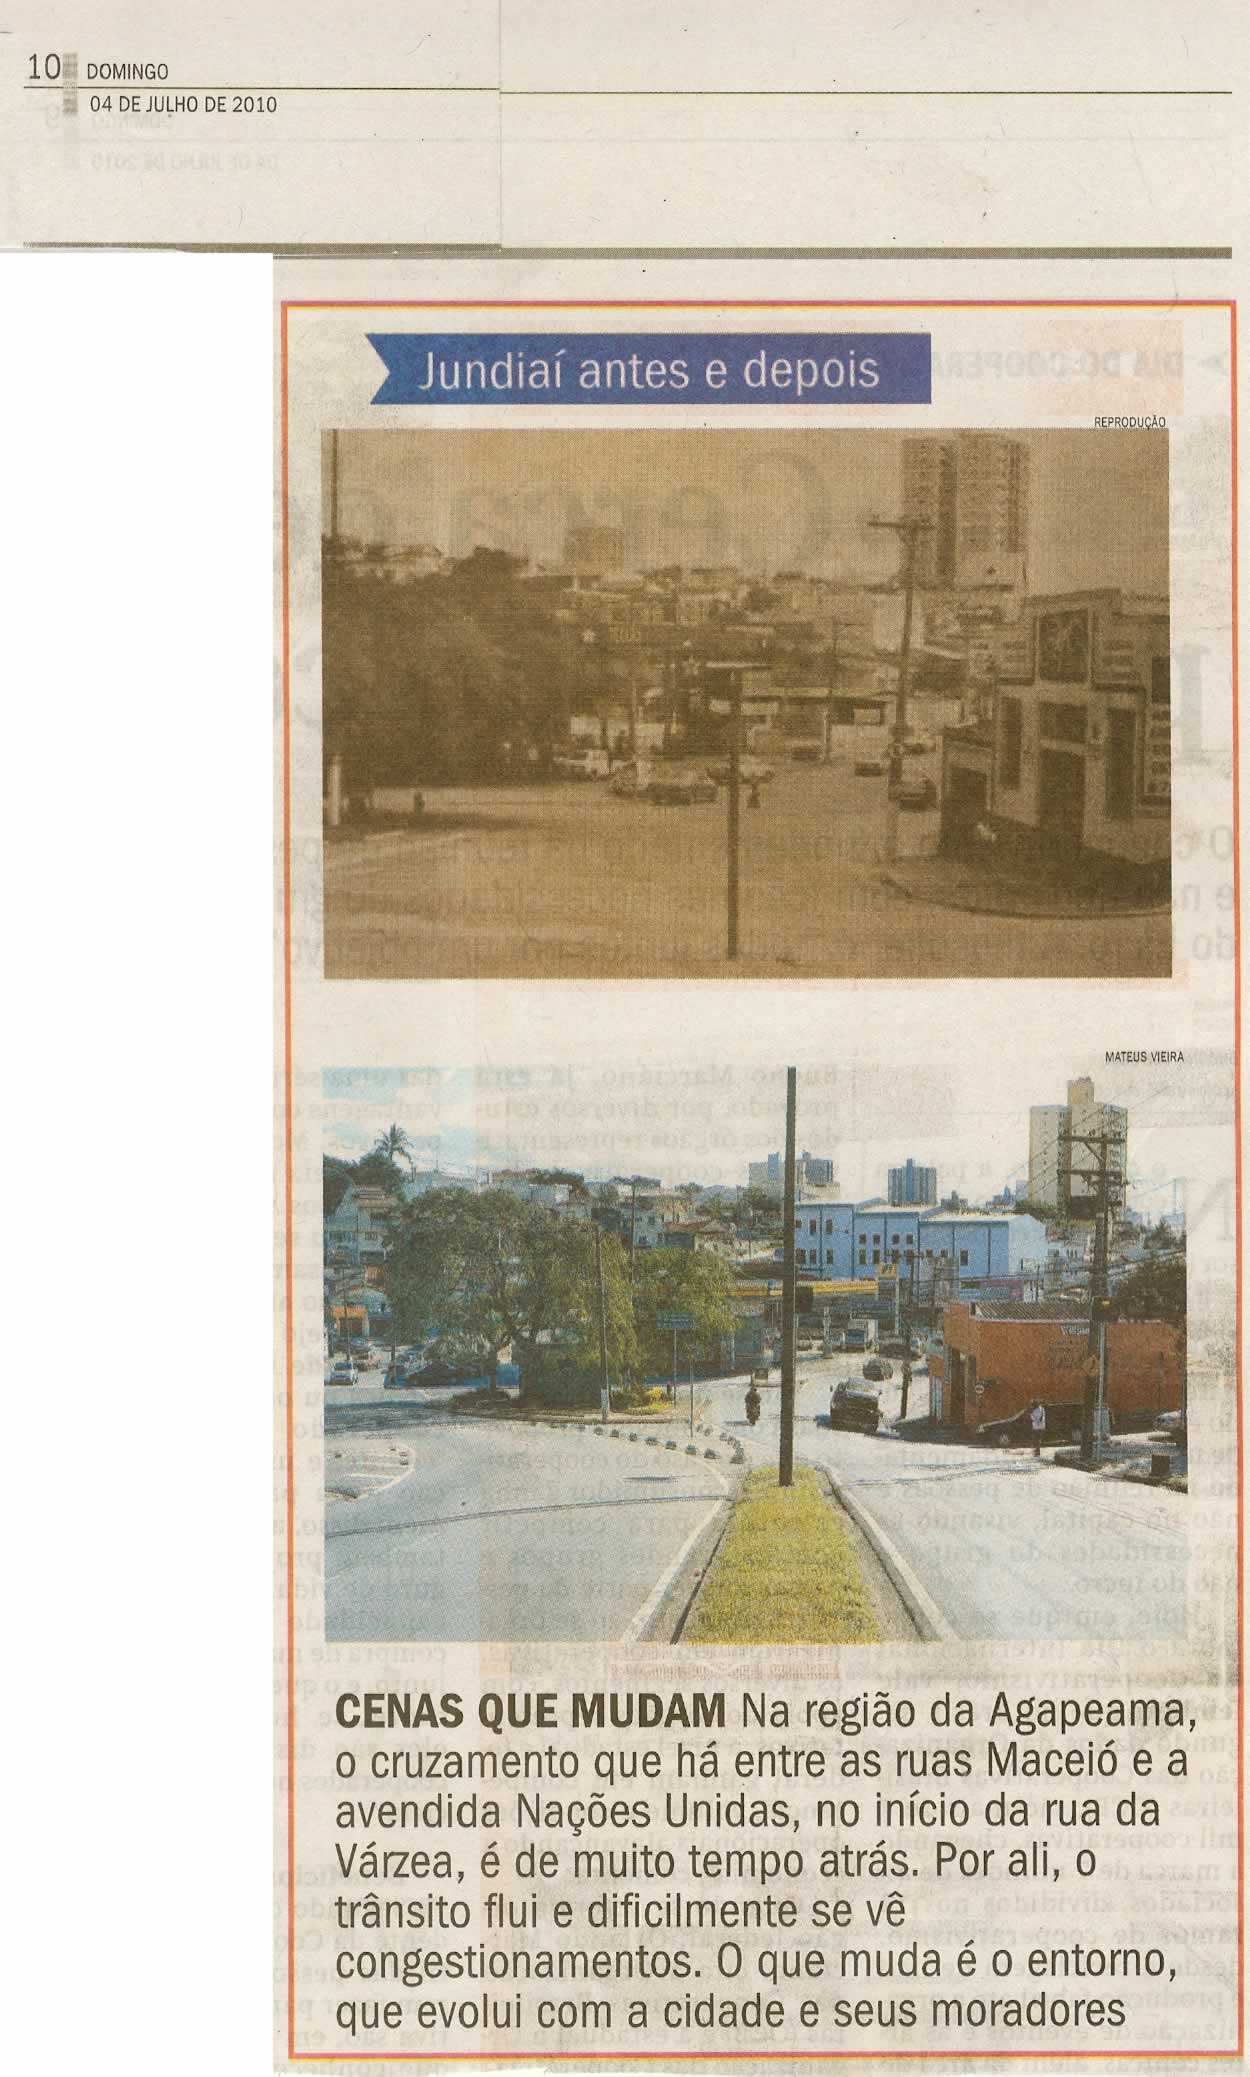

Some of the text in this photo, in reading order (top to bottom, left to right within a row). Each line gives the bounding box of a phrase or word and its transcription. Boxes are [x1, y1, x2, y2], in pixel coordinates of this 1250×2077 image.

[29, 53, 61, 80] 10
[87, 63, 169, 80] DOMINGO
[90, 95, 277, 113] 04 DE JULHO DE 2010
[419, 348, 881, 398] Jundiaí antes e depois
[1094, 415, 1167, 429] REPRODUÇÃO
[1105, 1051, 1185, 1063] MATEUS VIEIRA
[335, 1691, 1196, 1737] CENAS QUE MUDAM Na região da Agapeama,
[336, 1739, 1188, 1786] o cruzamento que há entre as ruas Maceió e a
[336, 1789, 1160, 1837] avendida Nações Unidas, no início da rua da
[335, 1839, 1096, 1885] Várzea, é de muito tempo atrás. Por ali, o
[334, 1890, 906, 1929] trânsito flui e dificilmente se vê
[336, 1939, 1176, 1987] congestionamentos. O que muda é o entorno,
[336, 1991, 1126, 2037] que evolui com a cidade e seus moradores
